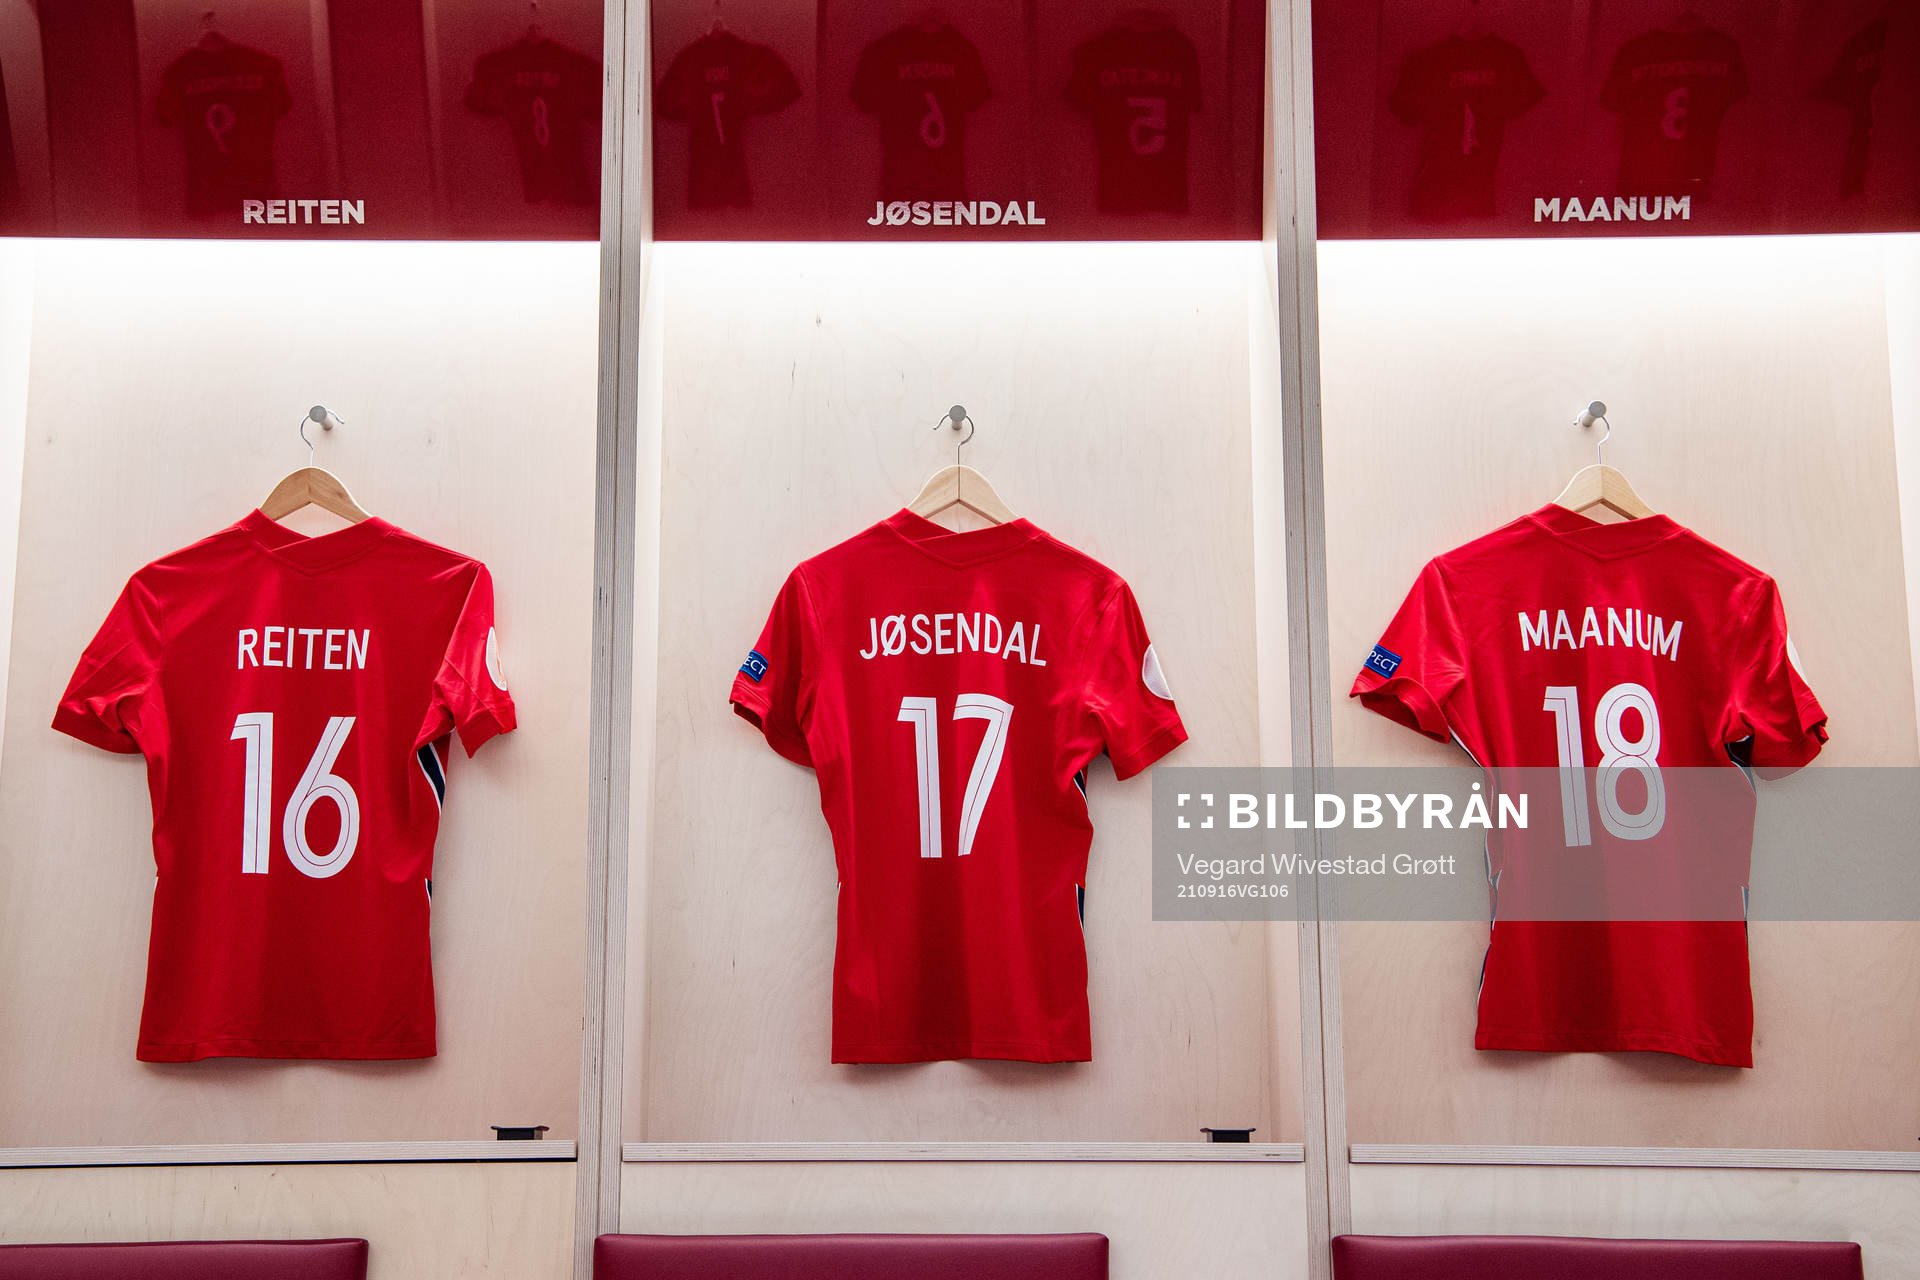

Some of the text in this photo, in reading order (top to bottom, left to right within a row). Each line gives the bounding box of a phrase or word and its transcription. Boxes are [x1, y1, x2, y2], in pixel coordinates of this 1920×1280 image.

[243, 200, 365, 224] REITEN
[867, 201, 1046, 226] JØSENDAL
[1534, 196, 1691, 222] MAANUM
[238, 626, 370, 670] REITEN
[860, 612, 1046, 667] JØSENDAL
[1518, 607, 1683, 662] MAANUM
[897, 693, 1014, 858] 17
[1543, 682, 1666, 847] 18
[230, 712, 360, 879] 16
